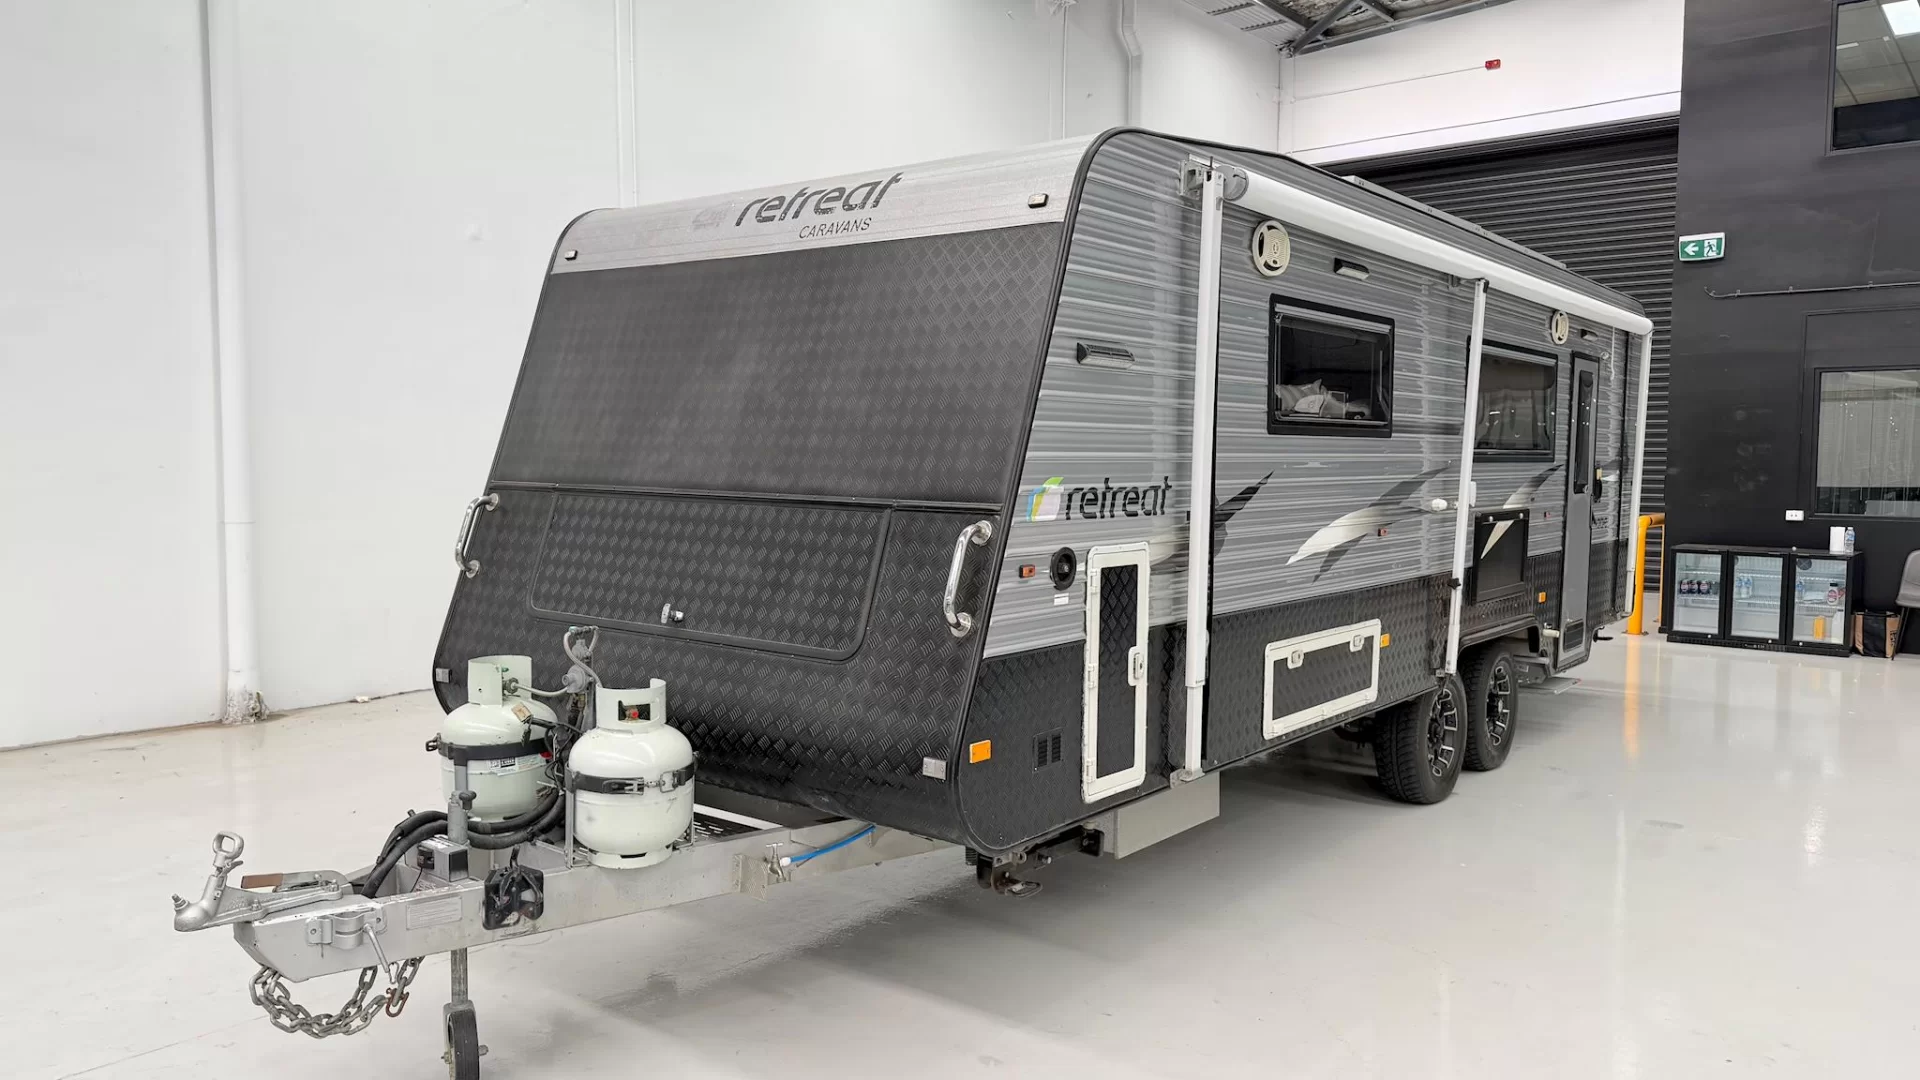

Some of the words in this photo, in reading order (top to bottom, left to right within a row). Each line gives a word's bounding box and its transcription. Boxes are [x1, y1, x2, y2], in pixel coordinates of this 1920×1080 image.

[735, 172, 904, 227] retreat
[799, 217, 872, 239] CARAVANS
[1065, 476, 1172, 520] retreat
